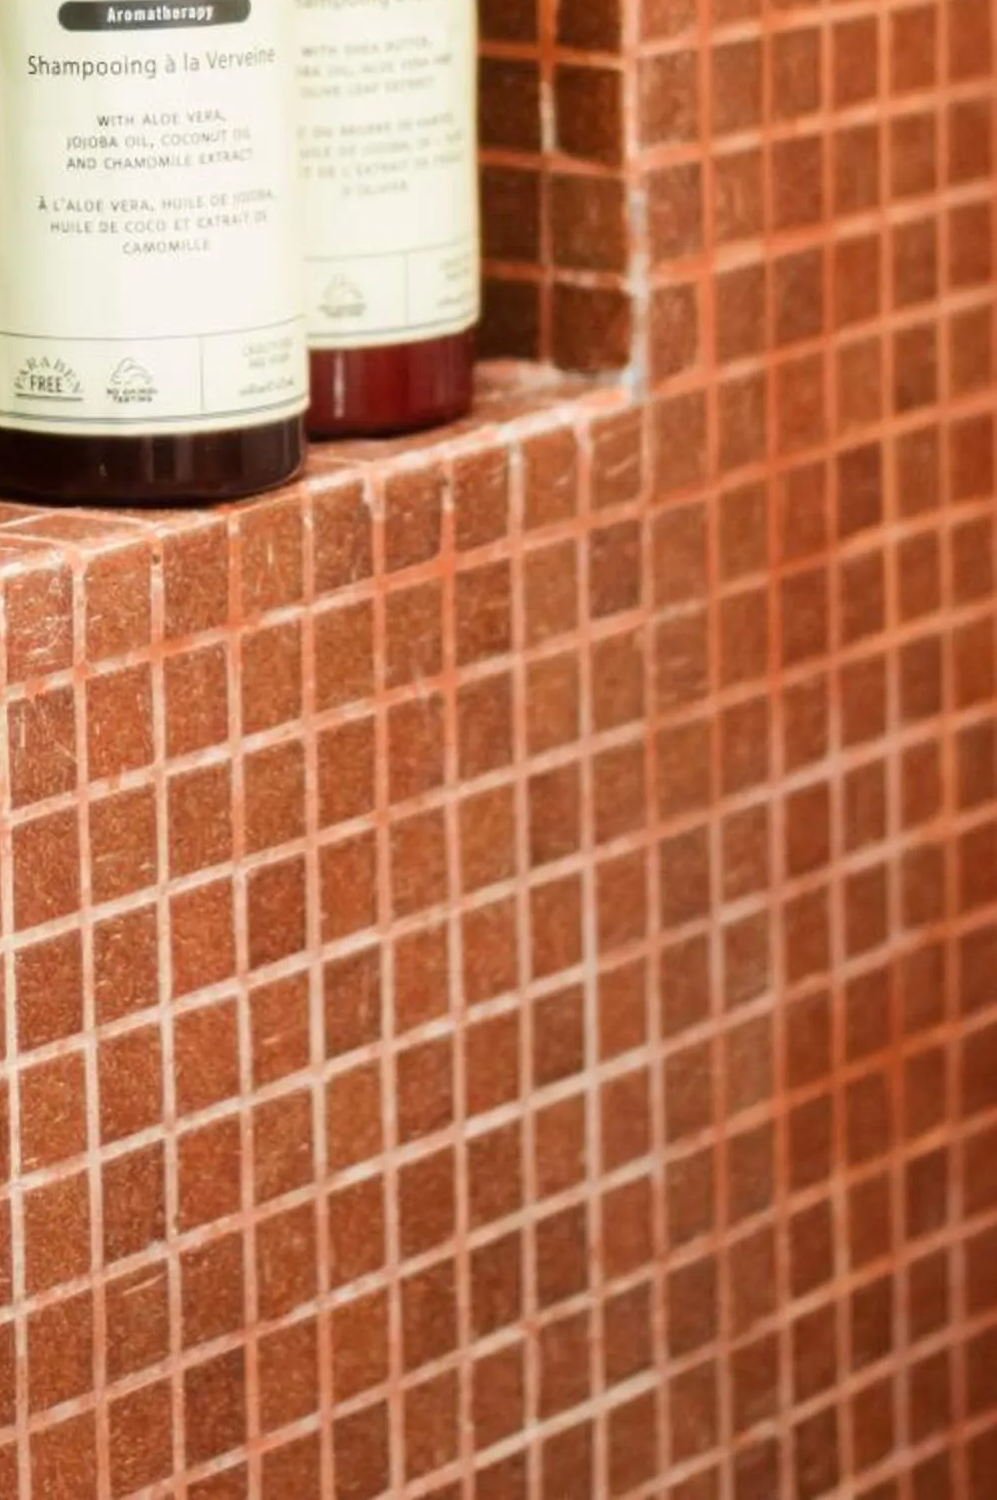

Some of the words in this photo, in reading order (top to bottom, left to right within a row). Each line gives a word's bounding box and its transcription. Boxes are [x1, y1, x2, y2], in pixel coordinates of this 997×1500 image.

[107, 4, 215, 24] Aromatherapy
[28, 55, 156, 80] Shampooing
[165, 54, 176, 73] à
[183, 54, 200, 71] la
[206, 47, 276, 70] Verveine
[97, 114, 134, 128] WITH
[143, 113, 180, 127] ALOE
[66, 135, 118, 150] JOJOBA
[125, 135, 154, 149] OIL,
[161, 129, 228, 147] COCONUT
[66, 156, 97, 170] AND
[104, 153, 192, 170] CHAMOMILE
[199, 147, 253, 165] EXTRACT
[210, 192, 229, 206] DE
[50, 220, 93, 234] HUILE
[98, 220, 119, 234] DE
[125, 219, 166, 234] COCO
[174, 218, 191, 232] ET
[122, 238, 210, 255] CAMOMILLE
[29, 374, 63, 394] FREE
